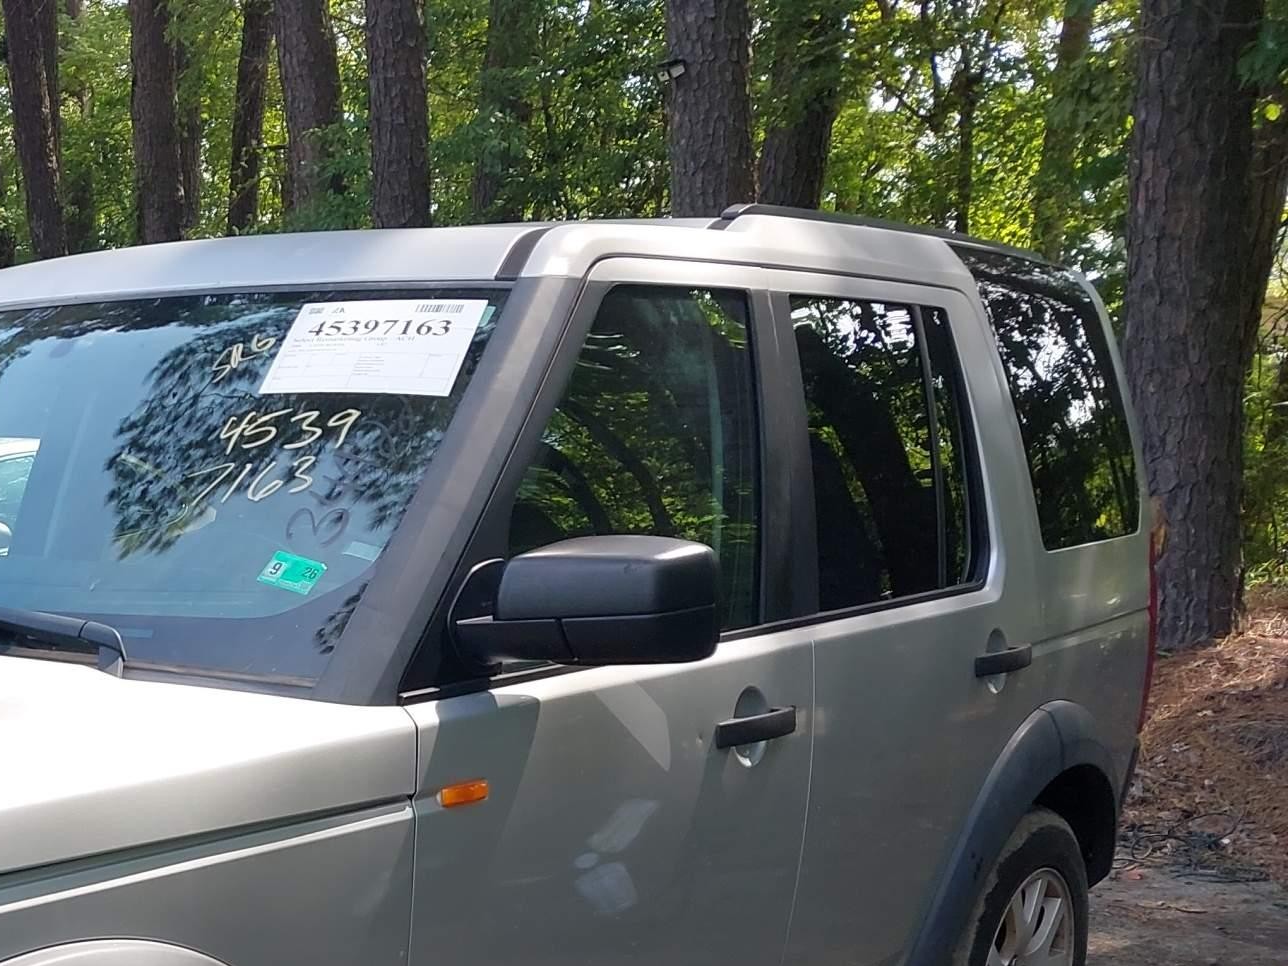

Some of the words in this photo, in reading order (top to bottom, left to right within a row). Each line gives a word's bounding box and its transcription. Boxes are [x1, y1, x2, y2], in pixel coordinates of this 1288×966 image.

[309, 319, 452, 336] 45397163
[219, 408, 362, 455] 4539
[187, 455, 317, 506] 7163
[269, 562, 283, 575] 9
[302, 566, 320, 580] 26
